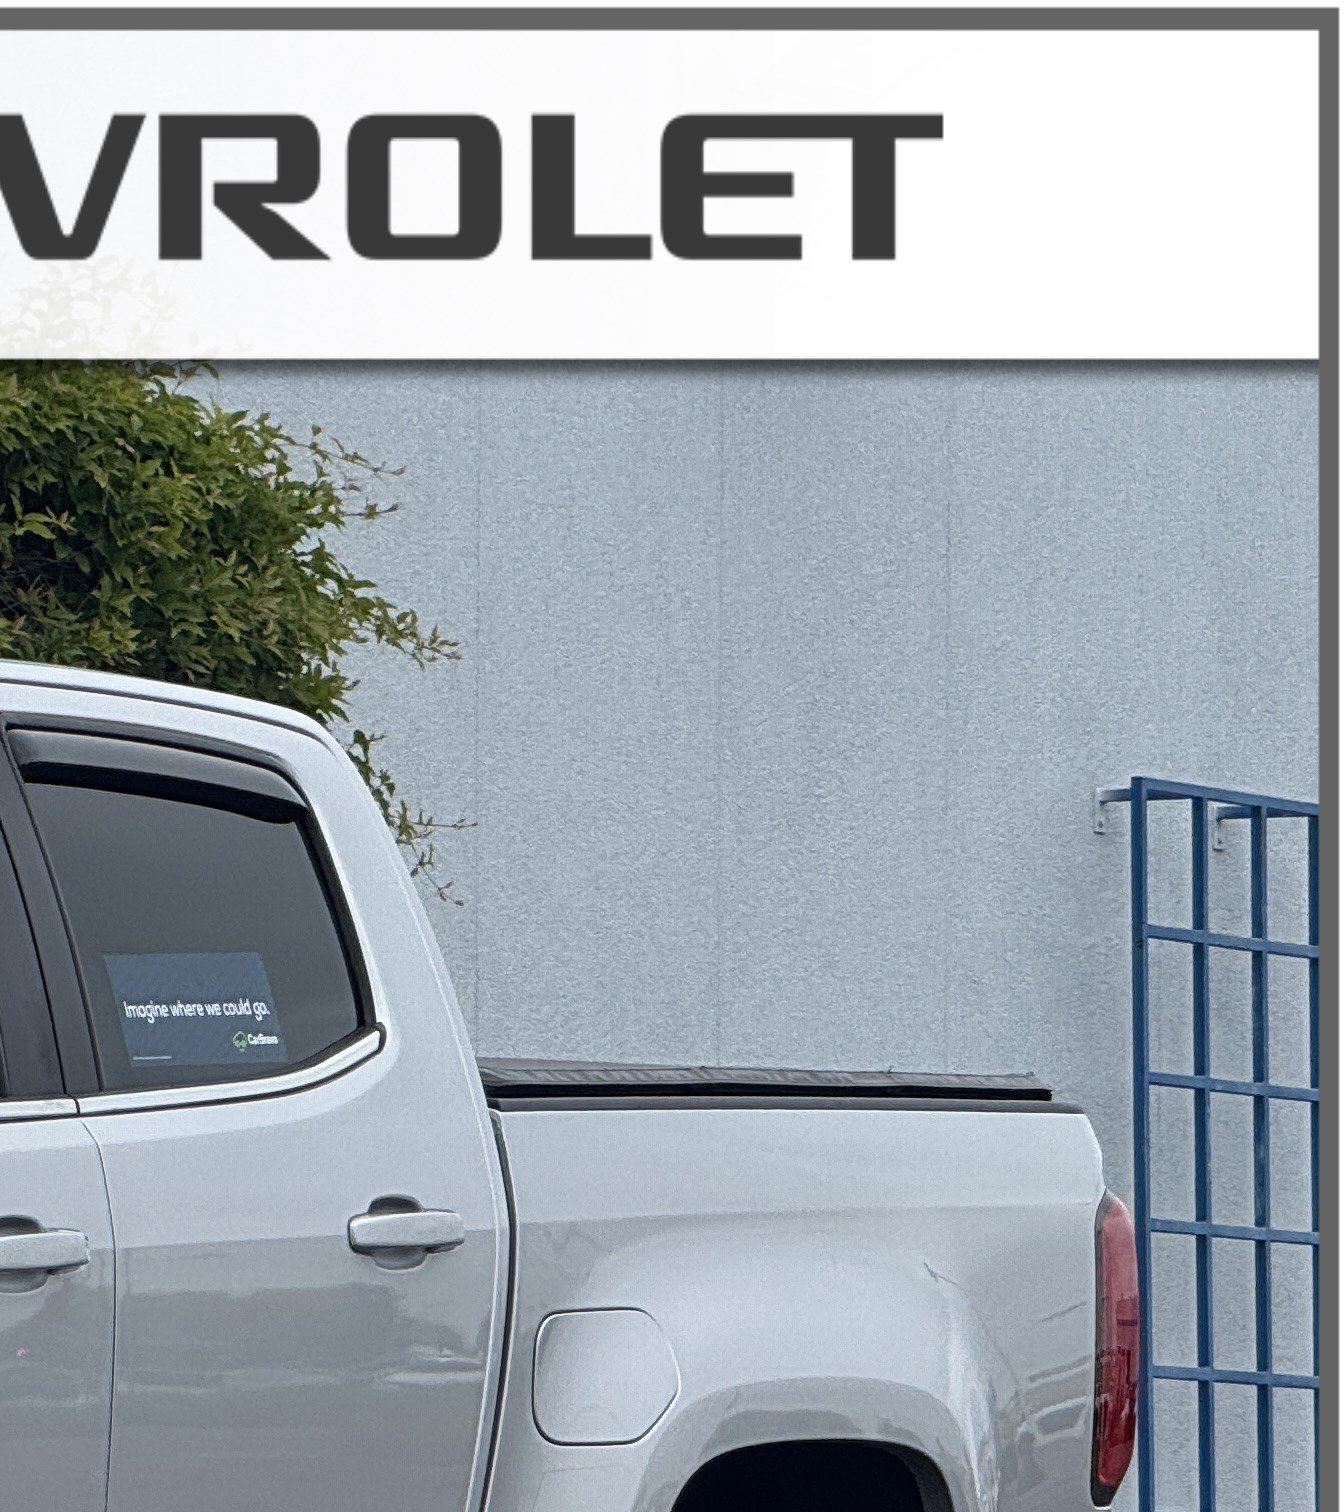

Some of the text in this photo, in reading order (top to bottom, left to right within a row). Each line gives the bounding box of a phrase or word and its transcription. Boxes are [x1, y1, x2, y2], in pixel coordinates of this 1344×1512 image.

[123, 998, 271, 1024] Imagine where we could go.
